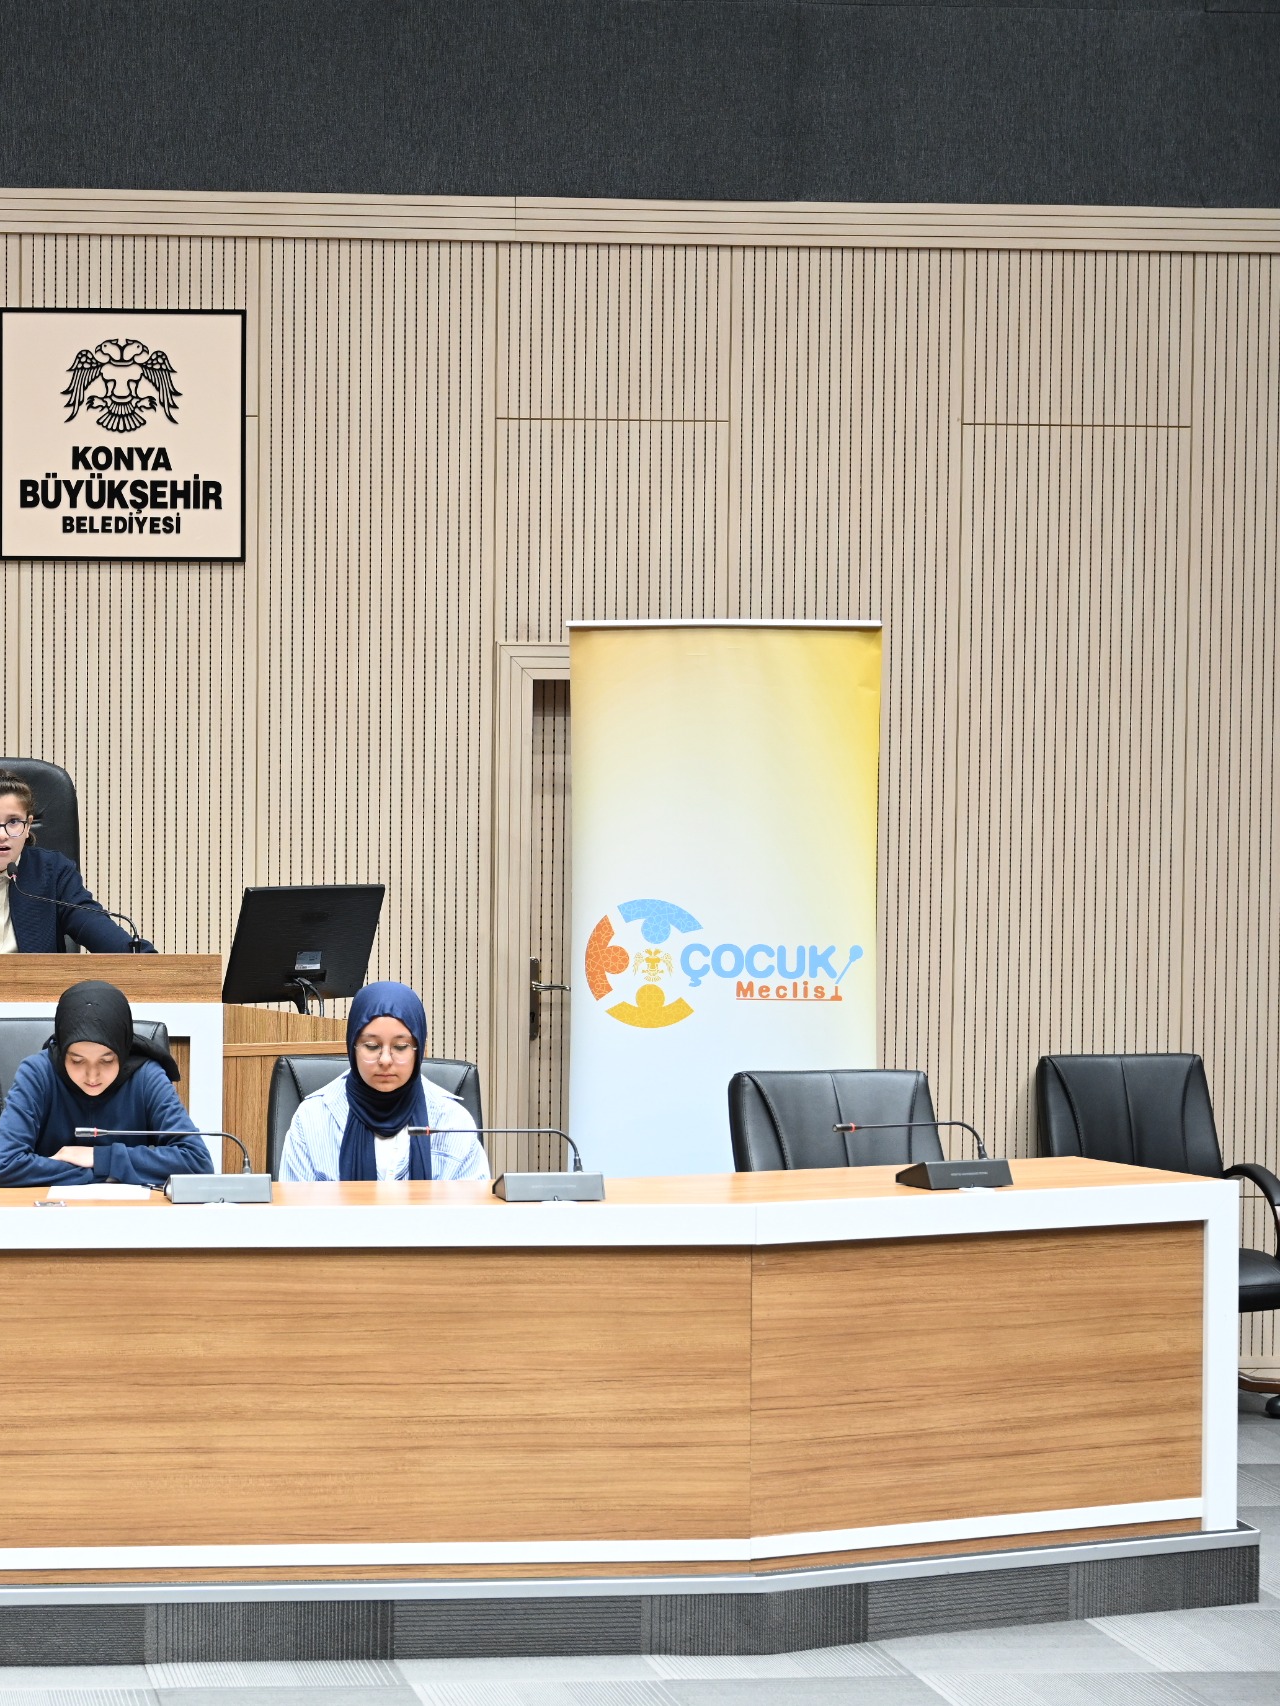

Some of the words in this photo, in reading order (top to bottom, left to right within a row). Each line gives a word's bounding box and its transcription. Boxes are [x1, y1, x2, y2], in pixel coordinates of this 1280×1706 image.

[71, 445, 173, 471] KONYA
[19, 473, 223, 515] BÜYÜKŞEHİR
[62, 513, 181, 535] BELEDİYESİ
[680, 943, 839, 988] ÇOCUK
